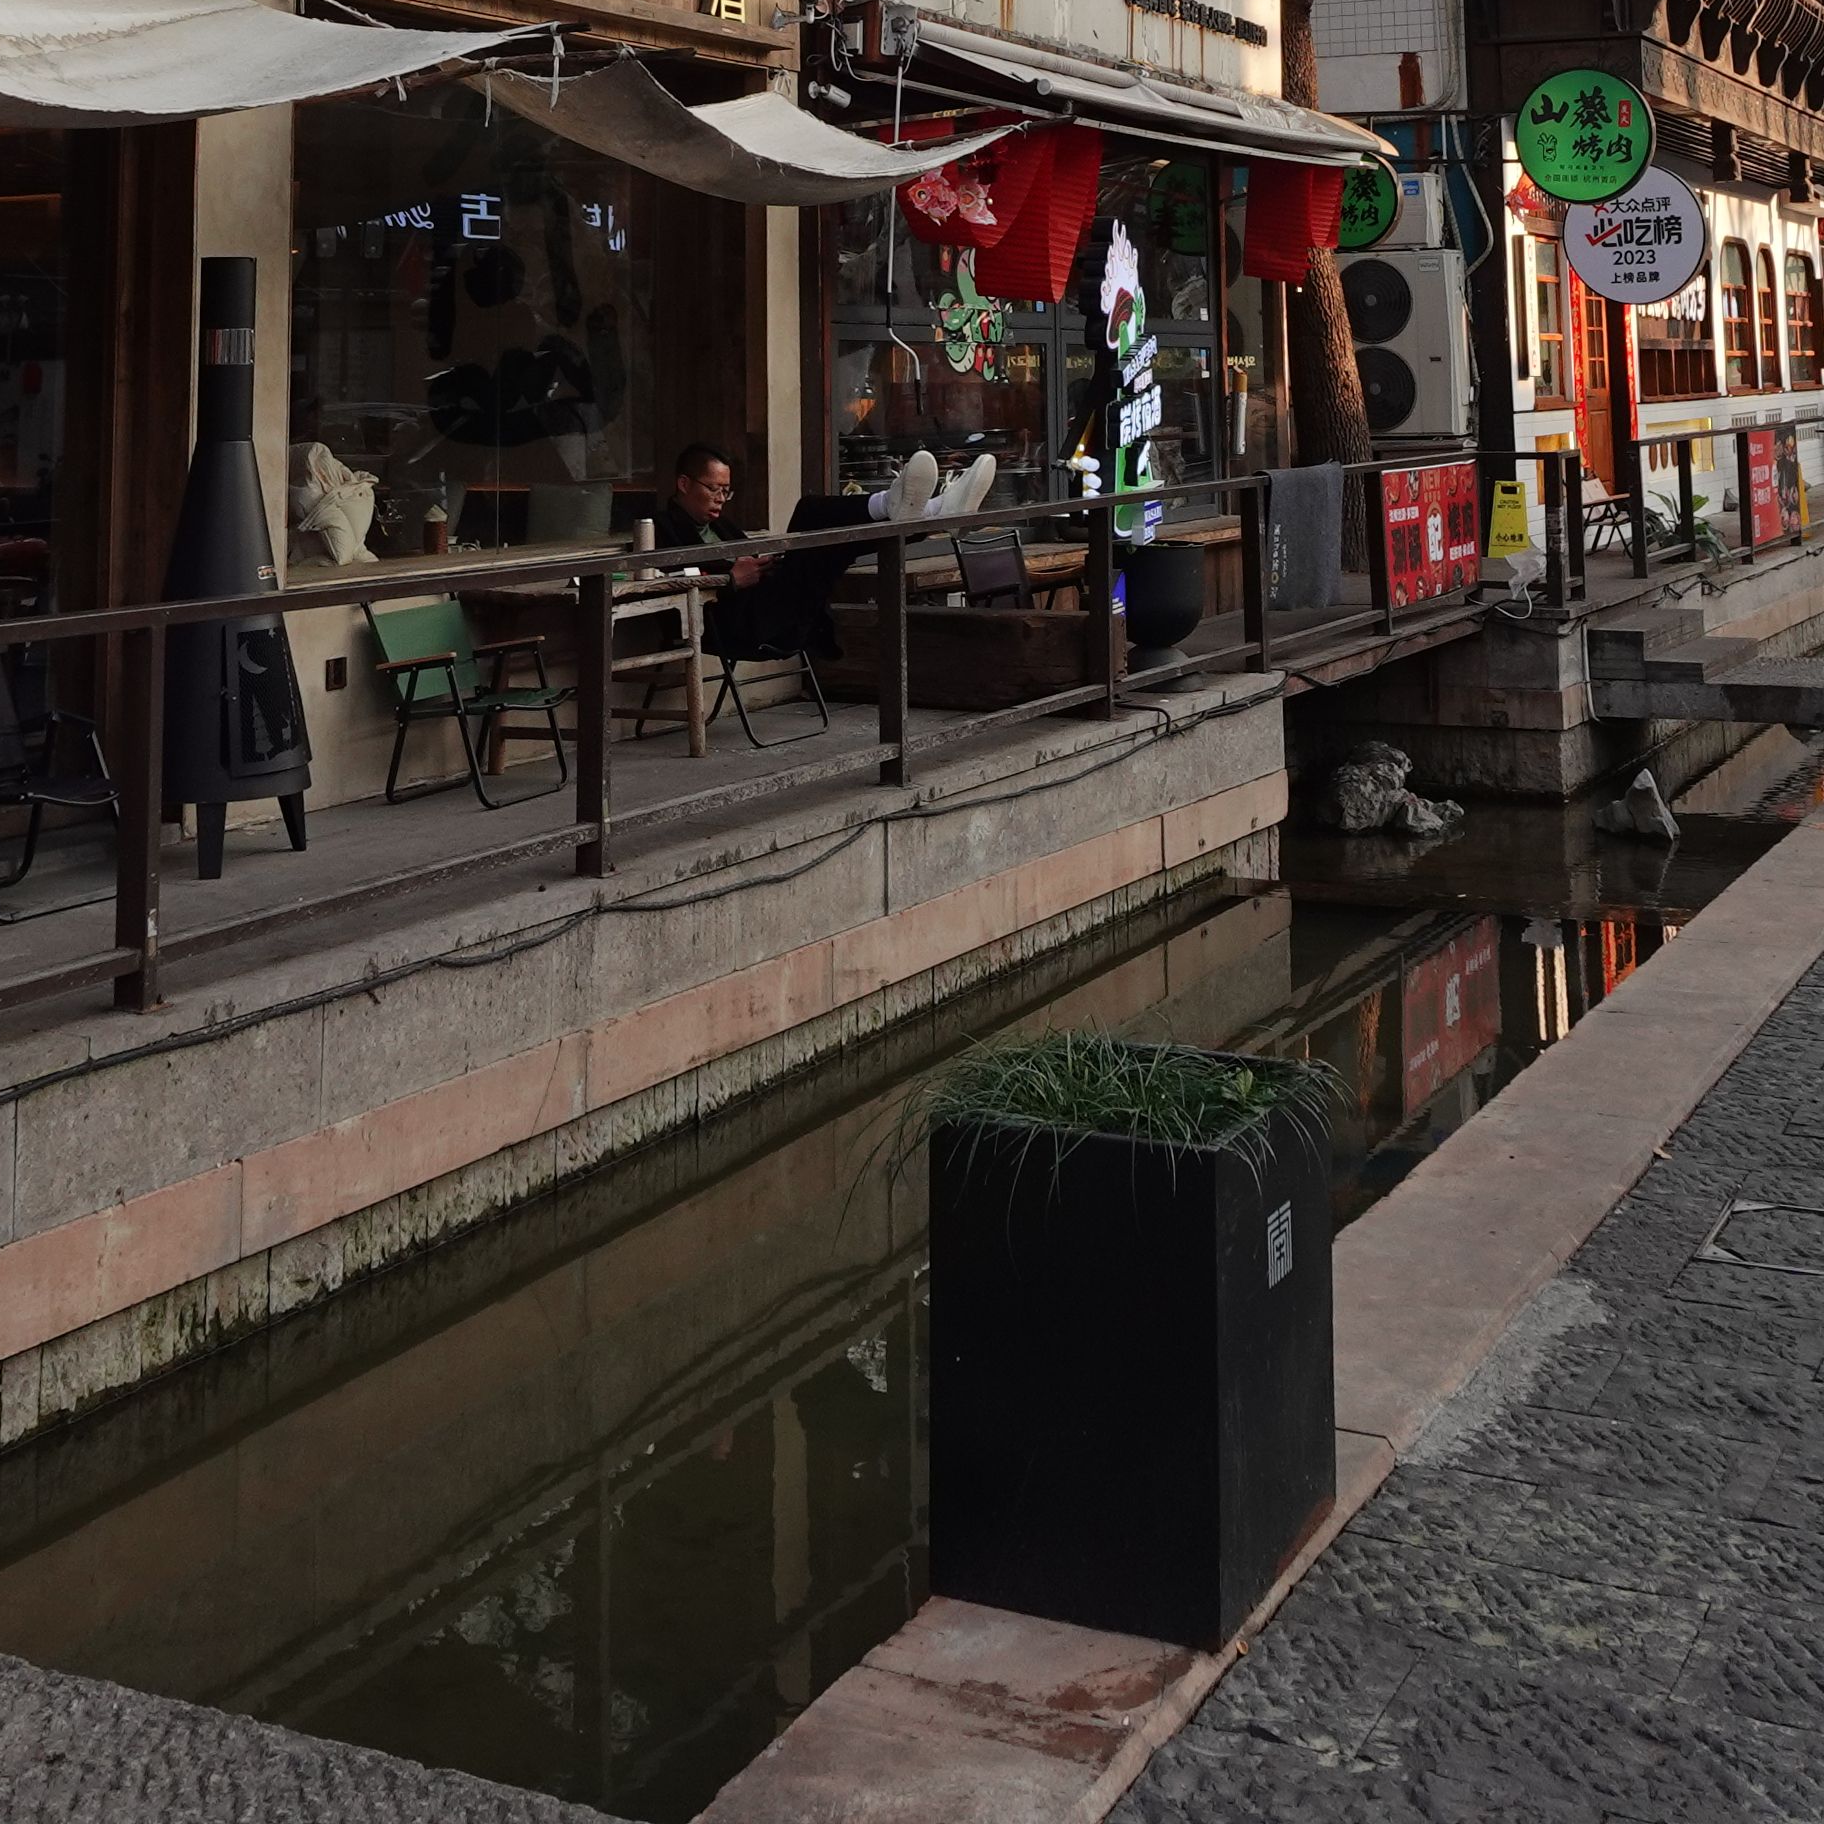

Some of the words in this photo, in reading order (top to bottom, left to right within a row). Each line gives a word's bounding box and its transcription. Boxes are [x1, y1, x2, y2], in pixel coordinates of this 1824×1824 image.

[1530, 85, 1613, 131] 山葵
[1572, 132, 1633, 164] 烤肉
[1610, 196, 1671, 214] 大众点评
[1585, 215, 1682, 249] 必吃榜
[1613, 249, 1656, 266] 2023
[1611, 271, 1660, 284] 上榜品牌
